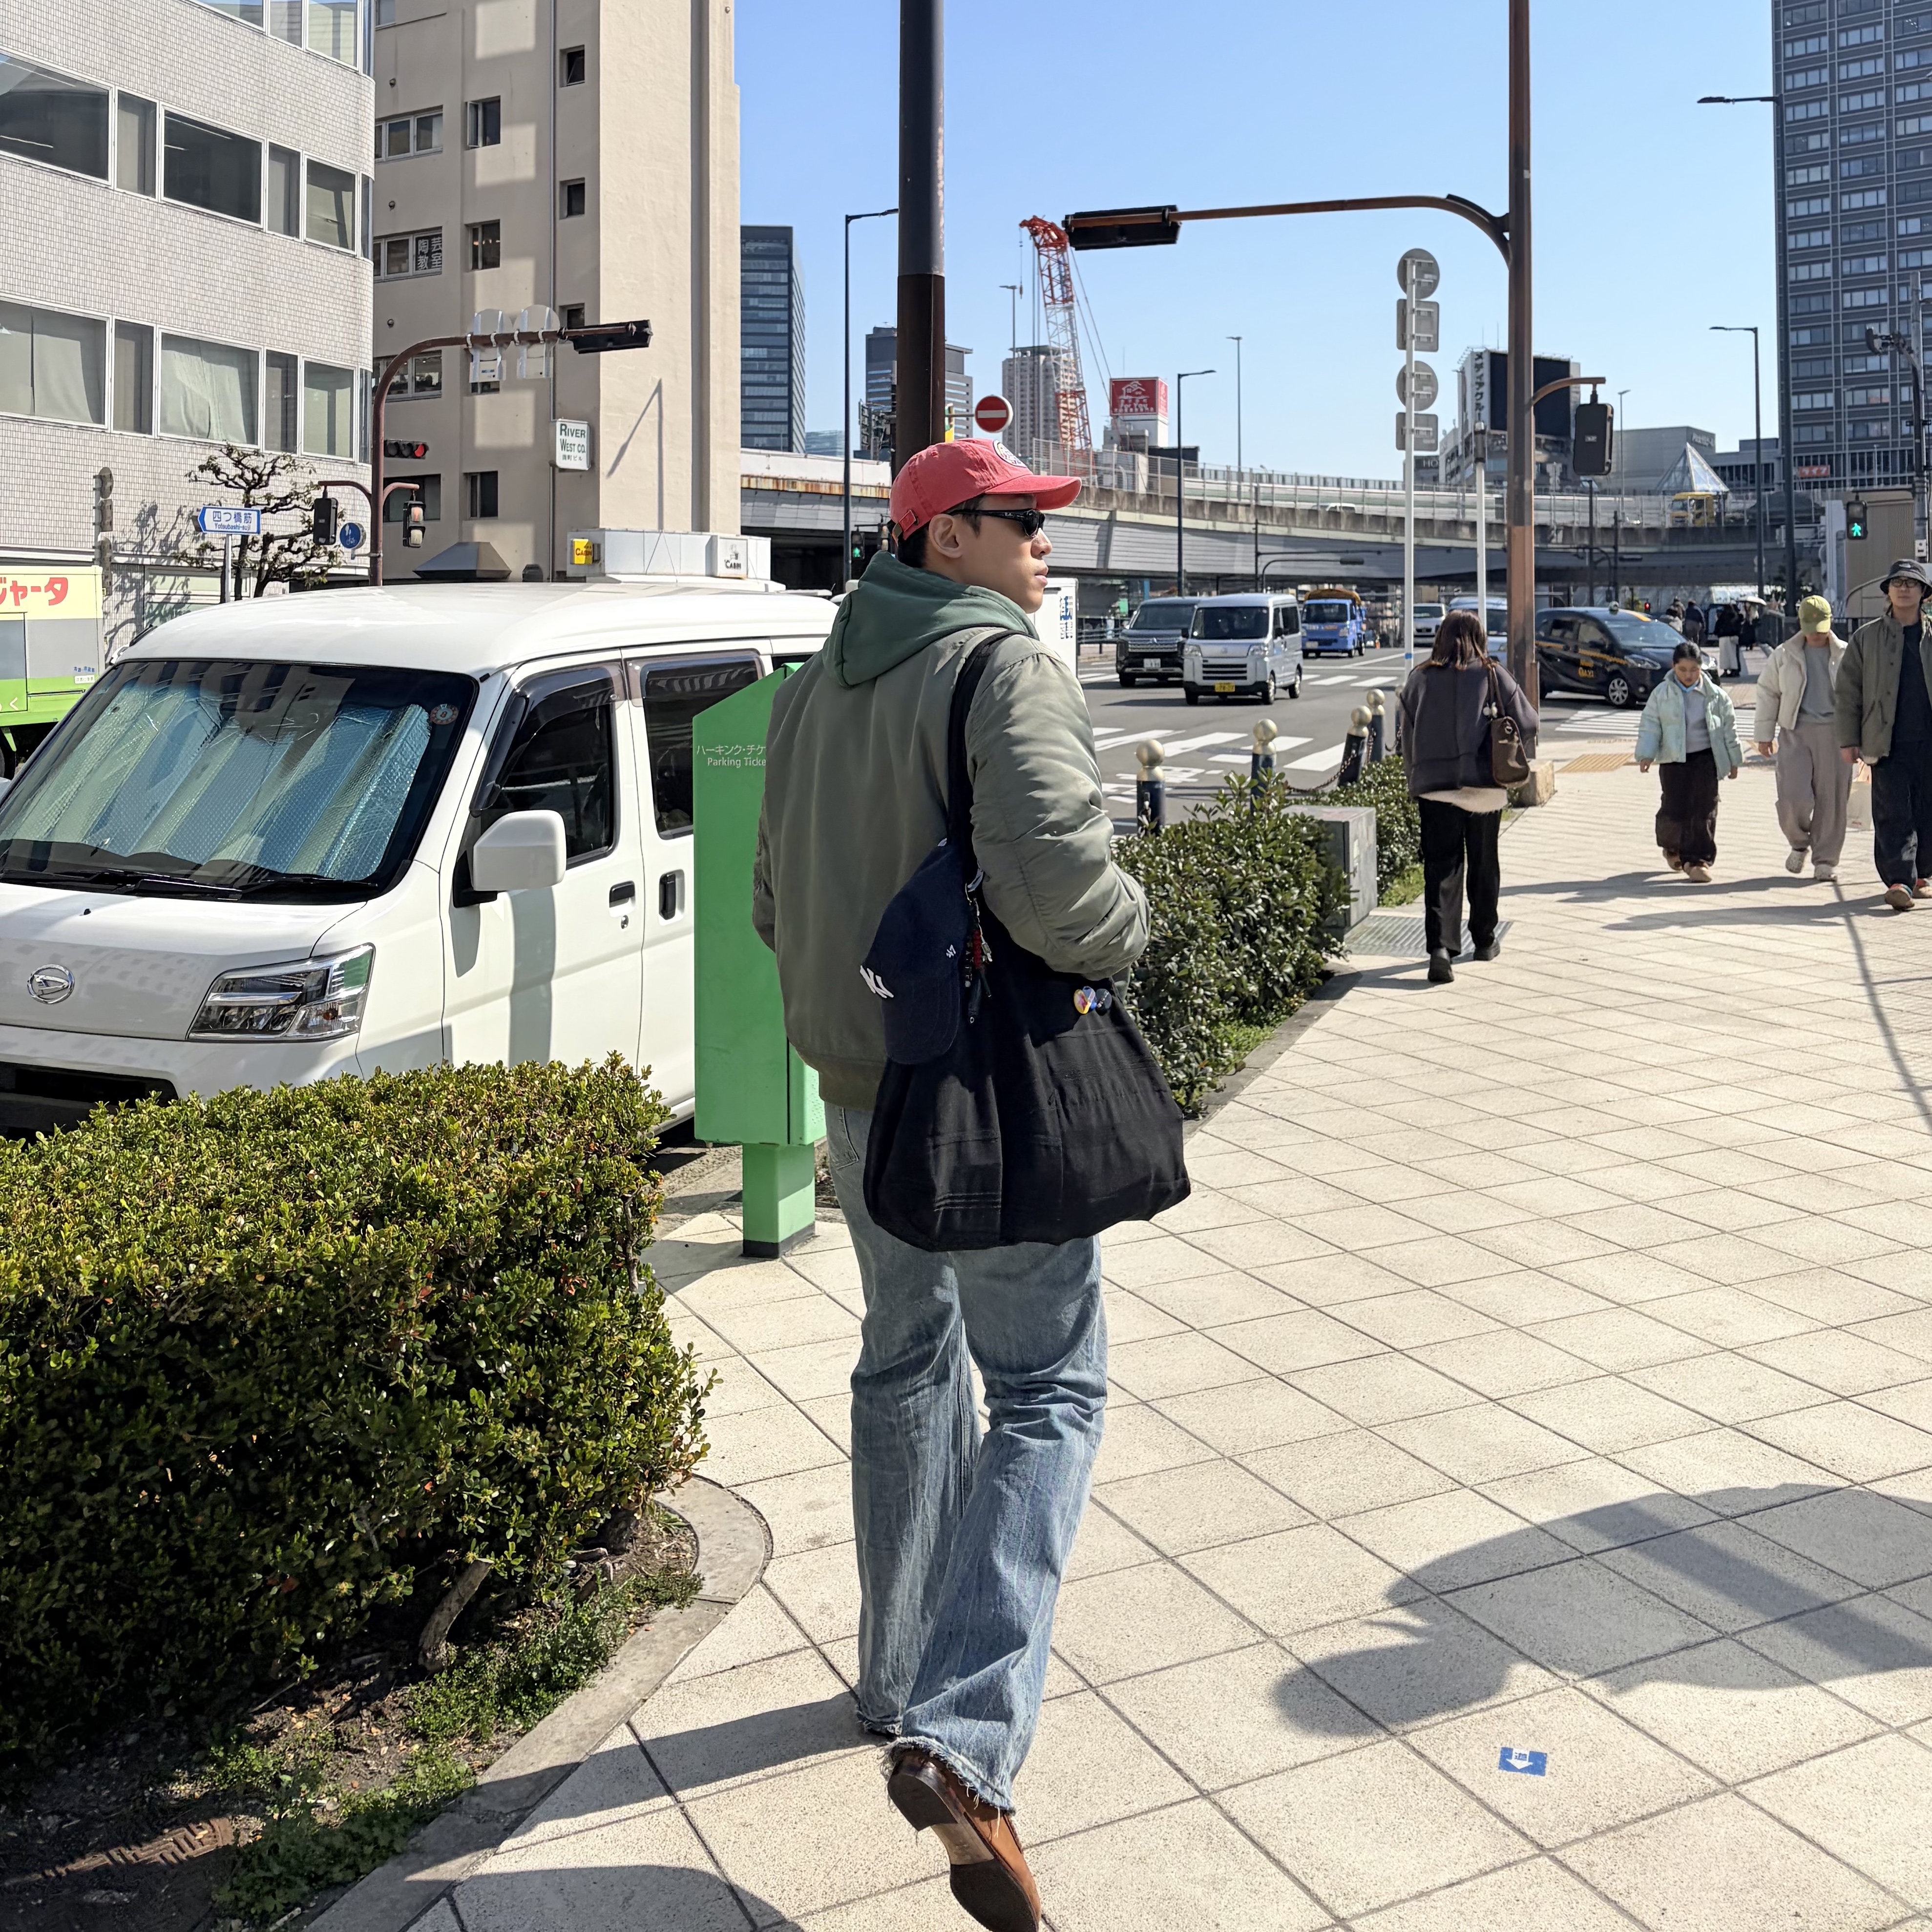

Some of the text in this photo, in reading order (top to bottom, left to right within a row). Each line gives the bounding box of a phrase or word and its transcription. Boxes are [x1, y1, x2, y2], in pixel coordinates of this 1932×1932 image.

[560, 423, 586, 438] RIVER
[560, 438, 576, 453] WEST
[212, 511, 252, 524] 四つ橋筋
[708, 757, 741, 769] Parking
